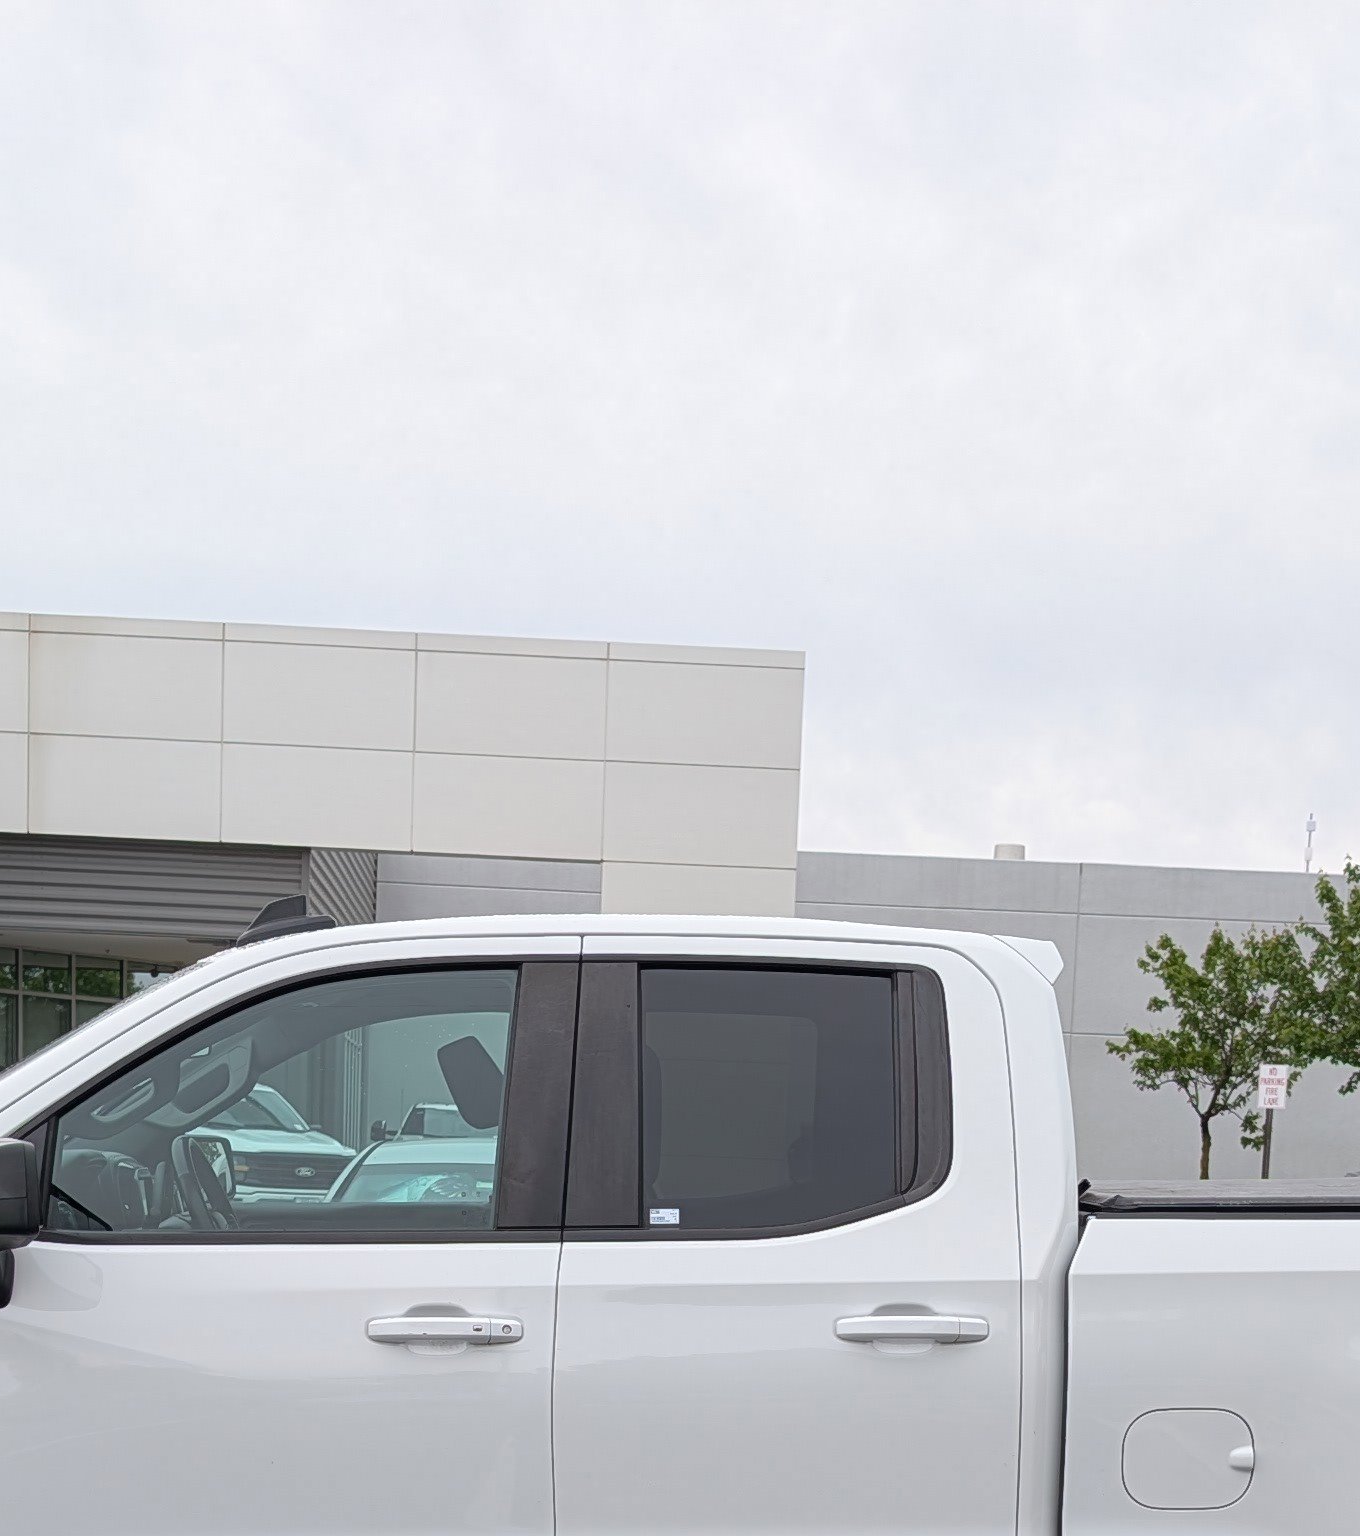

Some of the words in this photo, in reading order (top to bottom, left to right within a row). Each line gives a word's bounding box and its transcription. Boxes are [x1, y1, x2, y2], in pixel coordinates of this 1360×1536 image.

[1268, 1067, 1278, 1076] NO
[1260, 1077, 1286, 1086] PARKING
[1265, 1087, 1278, 1096] FIRE
[1264, 1097, 1278, 1106] LANE
